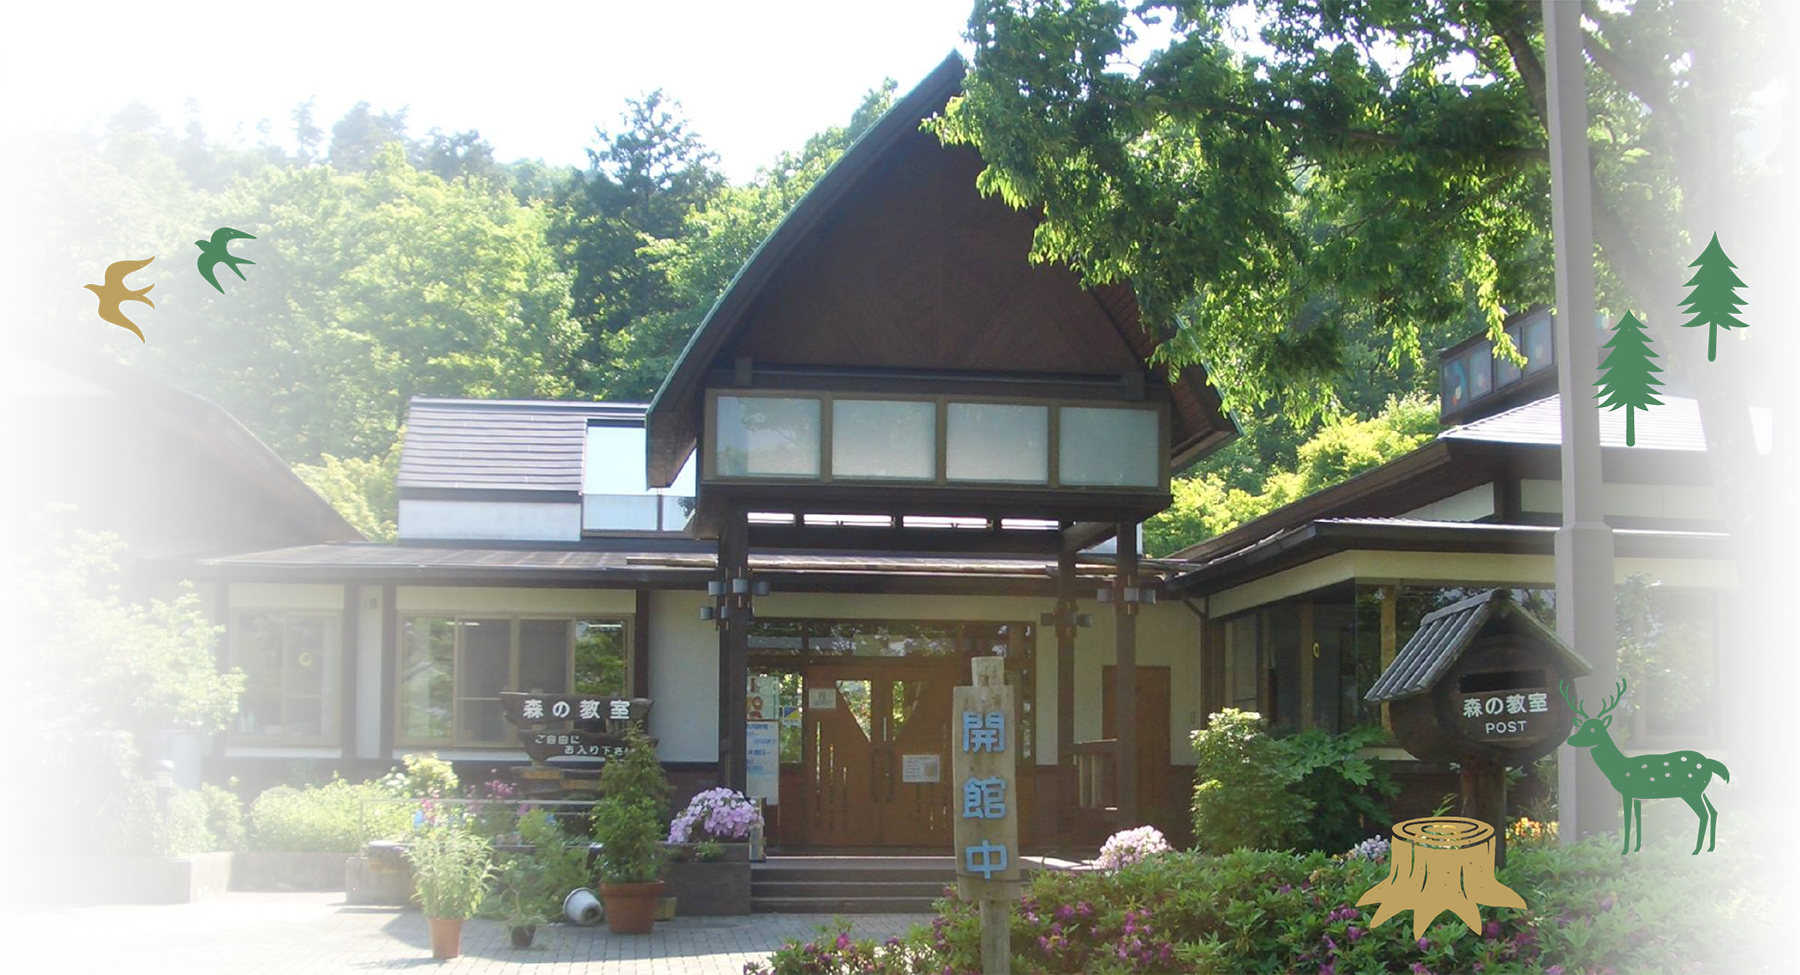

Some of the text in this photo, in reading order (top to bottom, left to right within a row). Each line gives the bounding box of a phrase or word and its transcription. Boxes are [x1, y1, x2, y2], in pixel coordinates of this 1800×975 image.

[523, 699, 631, 720] 森の教室
[1463, 692, 1548, 718] 森の教室
[1485, 720, 1527, 735] POST
[534, 734, 581, 745] ご自由に
[962, 710, 1008, 881] 開館中
